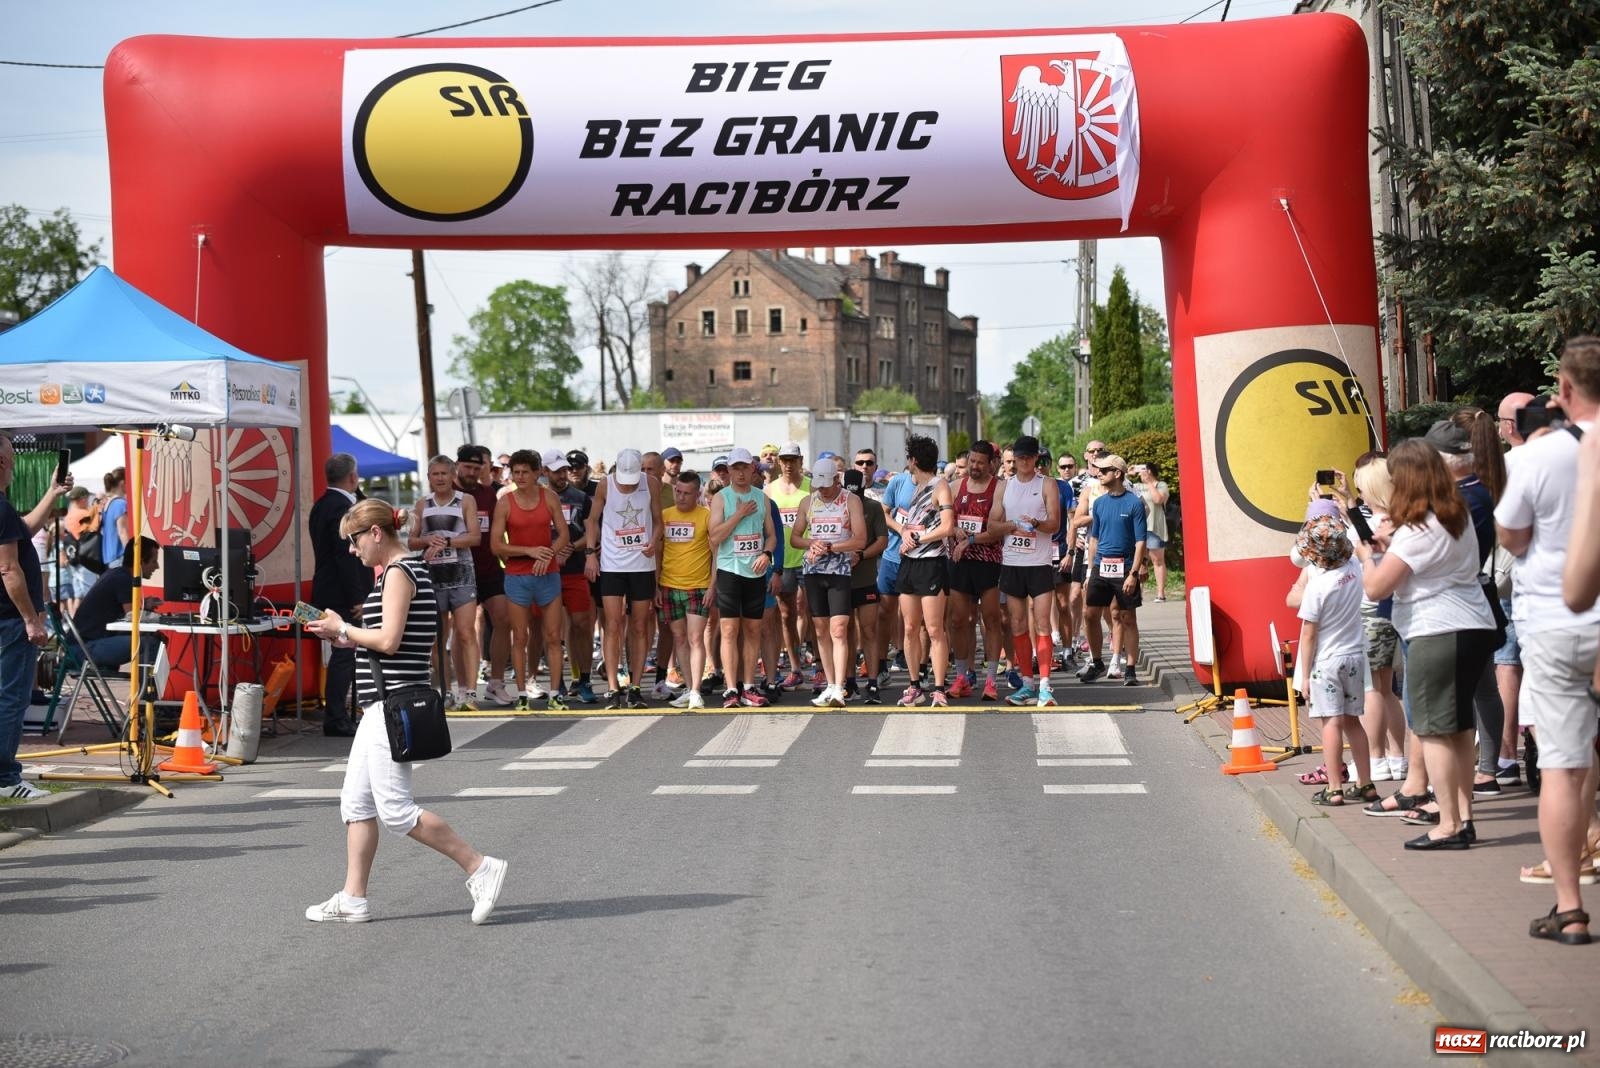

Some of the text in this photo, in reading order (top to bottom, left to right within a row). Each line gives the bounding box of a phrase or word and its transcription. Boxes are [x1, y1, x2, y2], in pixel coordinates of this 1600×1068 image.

[685, 60, 832, 93] BIEG
[439, 84, 529, 117] SIR
[579, 110, 939, 159] BEZ GRANIC
[610, 168, 911, 216] RACIBÓRZ
[170, 391, 201, 401] MITKO
[1295, 378, 1372, 416] SIR
[783, 513, 798, 523] 13
[671, 527, 689, 537] 143
[816, 524, 837, 533] 202
[960, 521, 977, 532] 138
[621, 535, 641, 546] 184
[739, 540, 759, 551] 238
[1012, 536, 1031, 548] 236
[1103, 563, 1118, 573] 173
